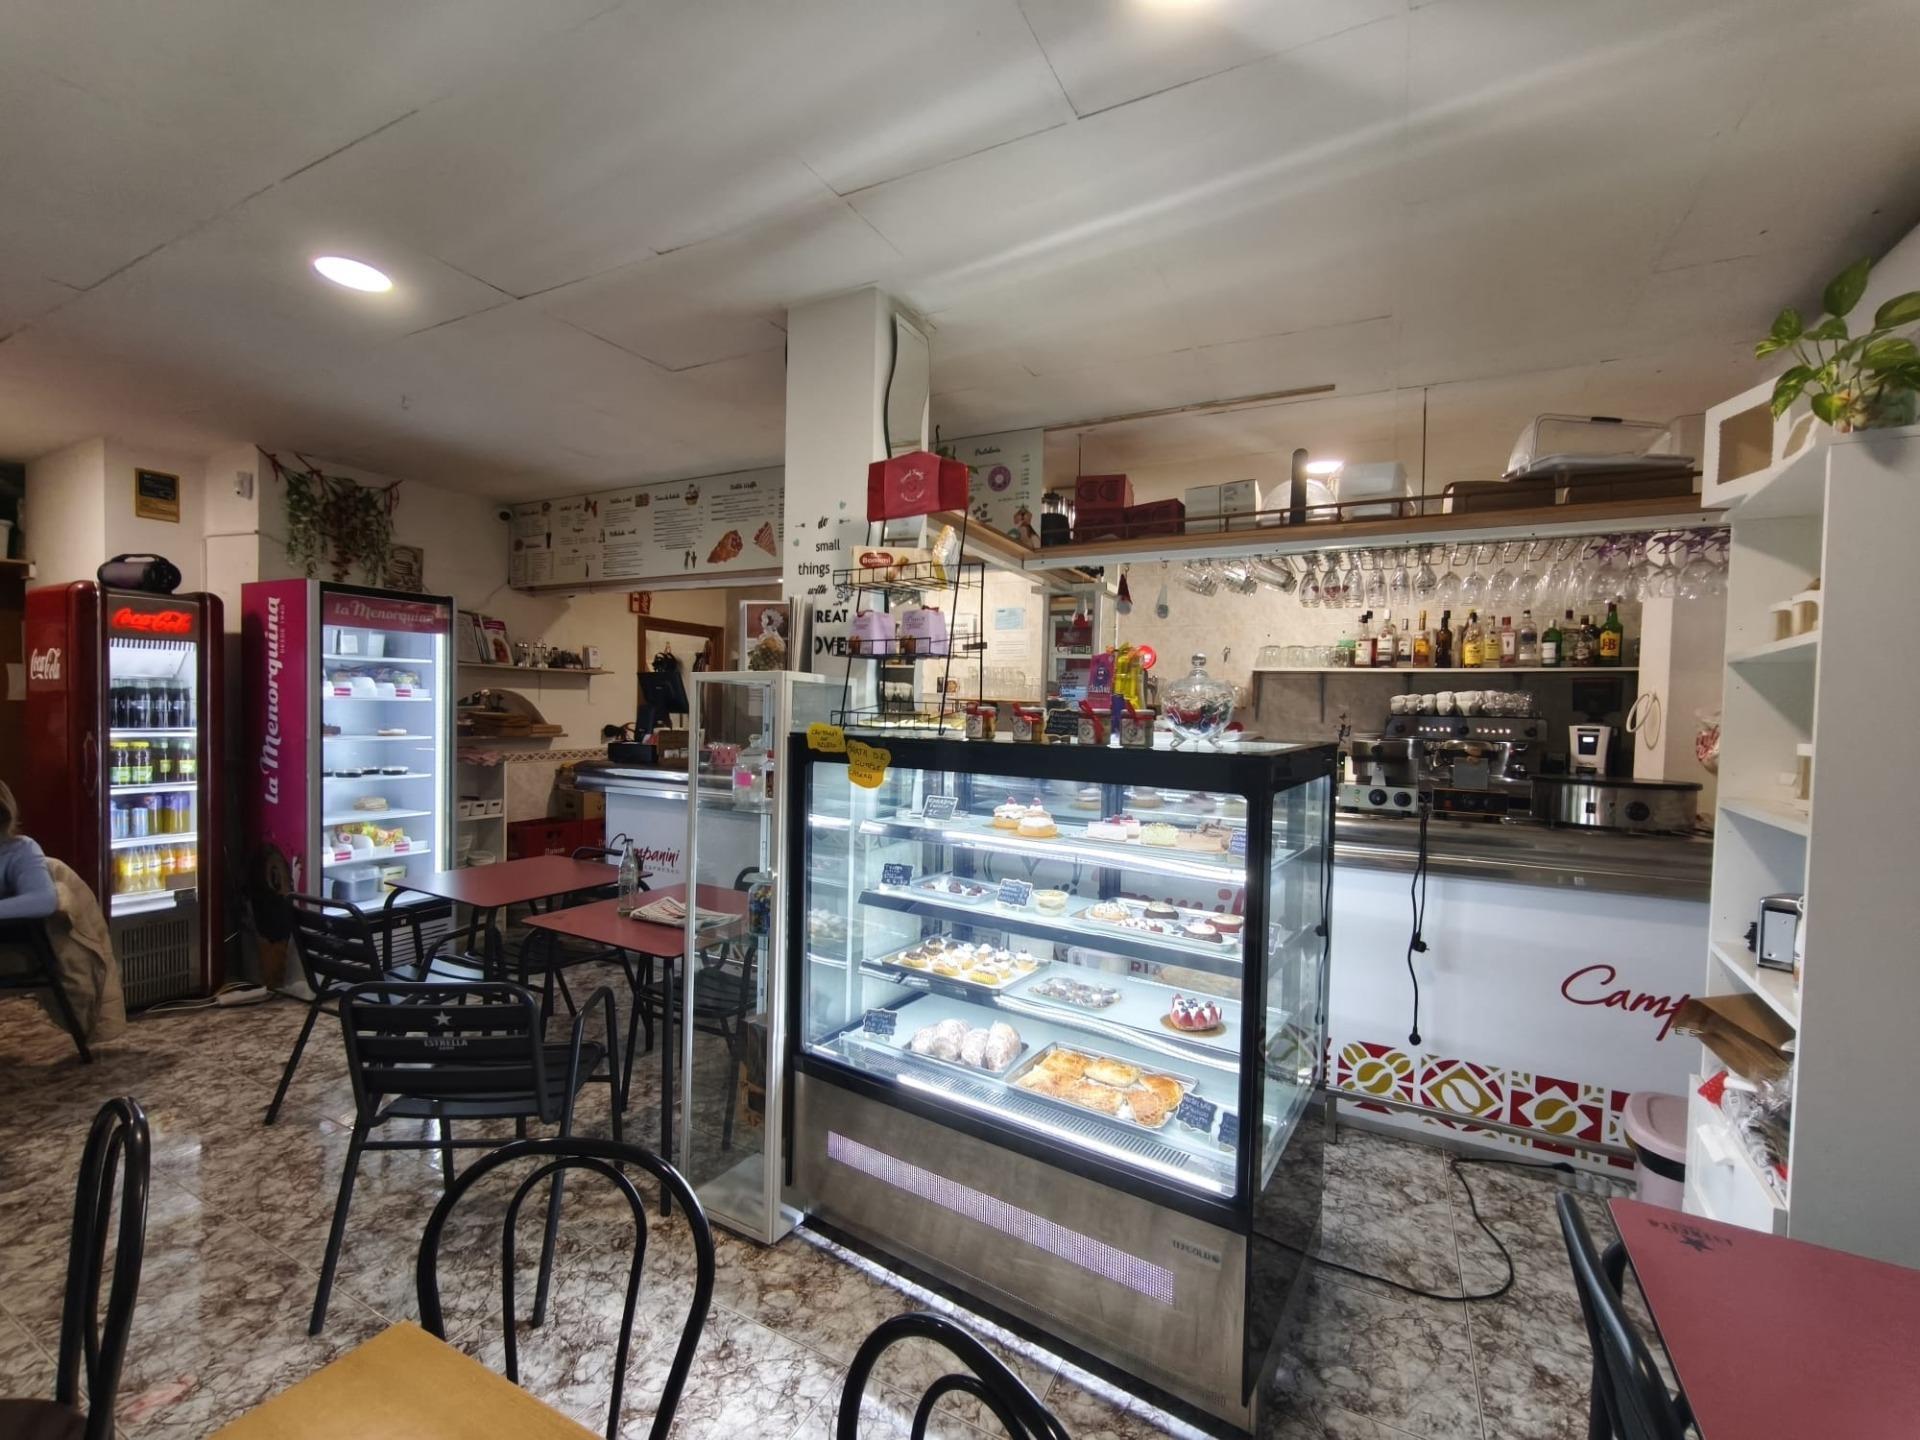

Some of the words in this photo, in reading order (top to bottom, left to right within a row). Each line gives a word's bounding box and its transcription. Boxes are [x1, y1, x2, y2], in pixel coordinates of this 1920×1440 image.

[817, 516, 829, 529] do
[815, 538, 840, 552] small
[798, 562, 830, 578] things
[807, 584, 829, 595] with
[815, 609, 849, 624] REAT
[814, 637, 847, 655] OVE
[259, 597, 283, 774] Menorquina
[265, 776, 279, 805] la
[610, 833, 681, 868] Cmpanini
